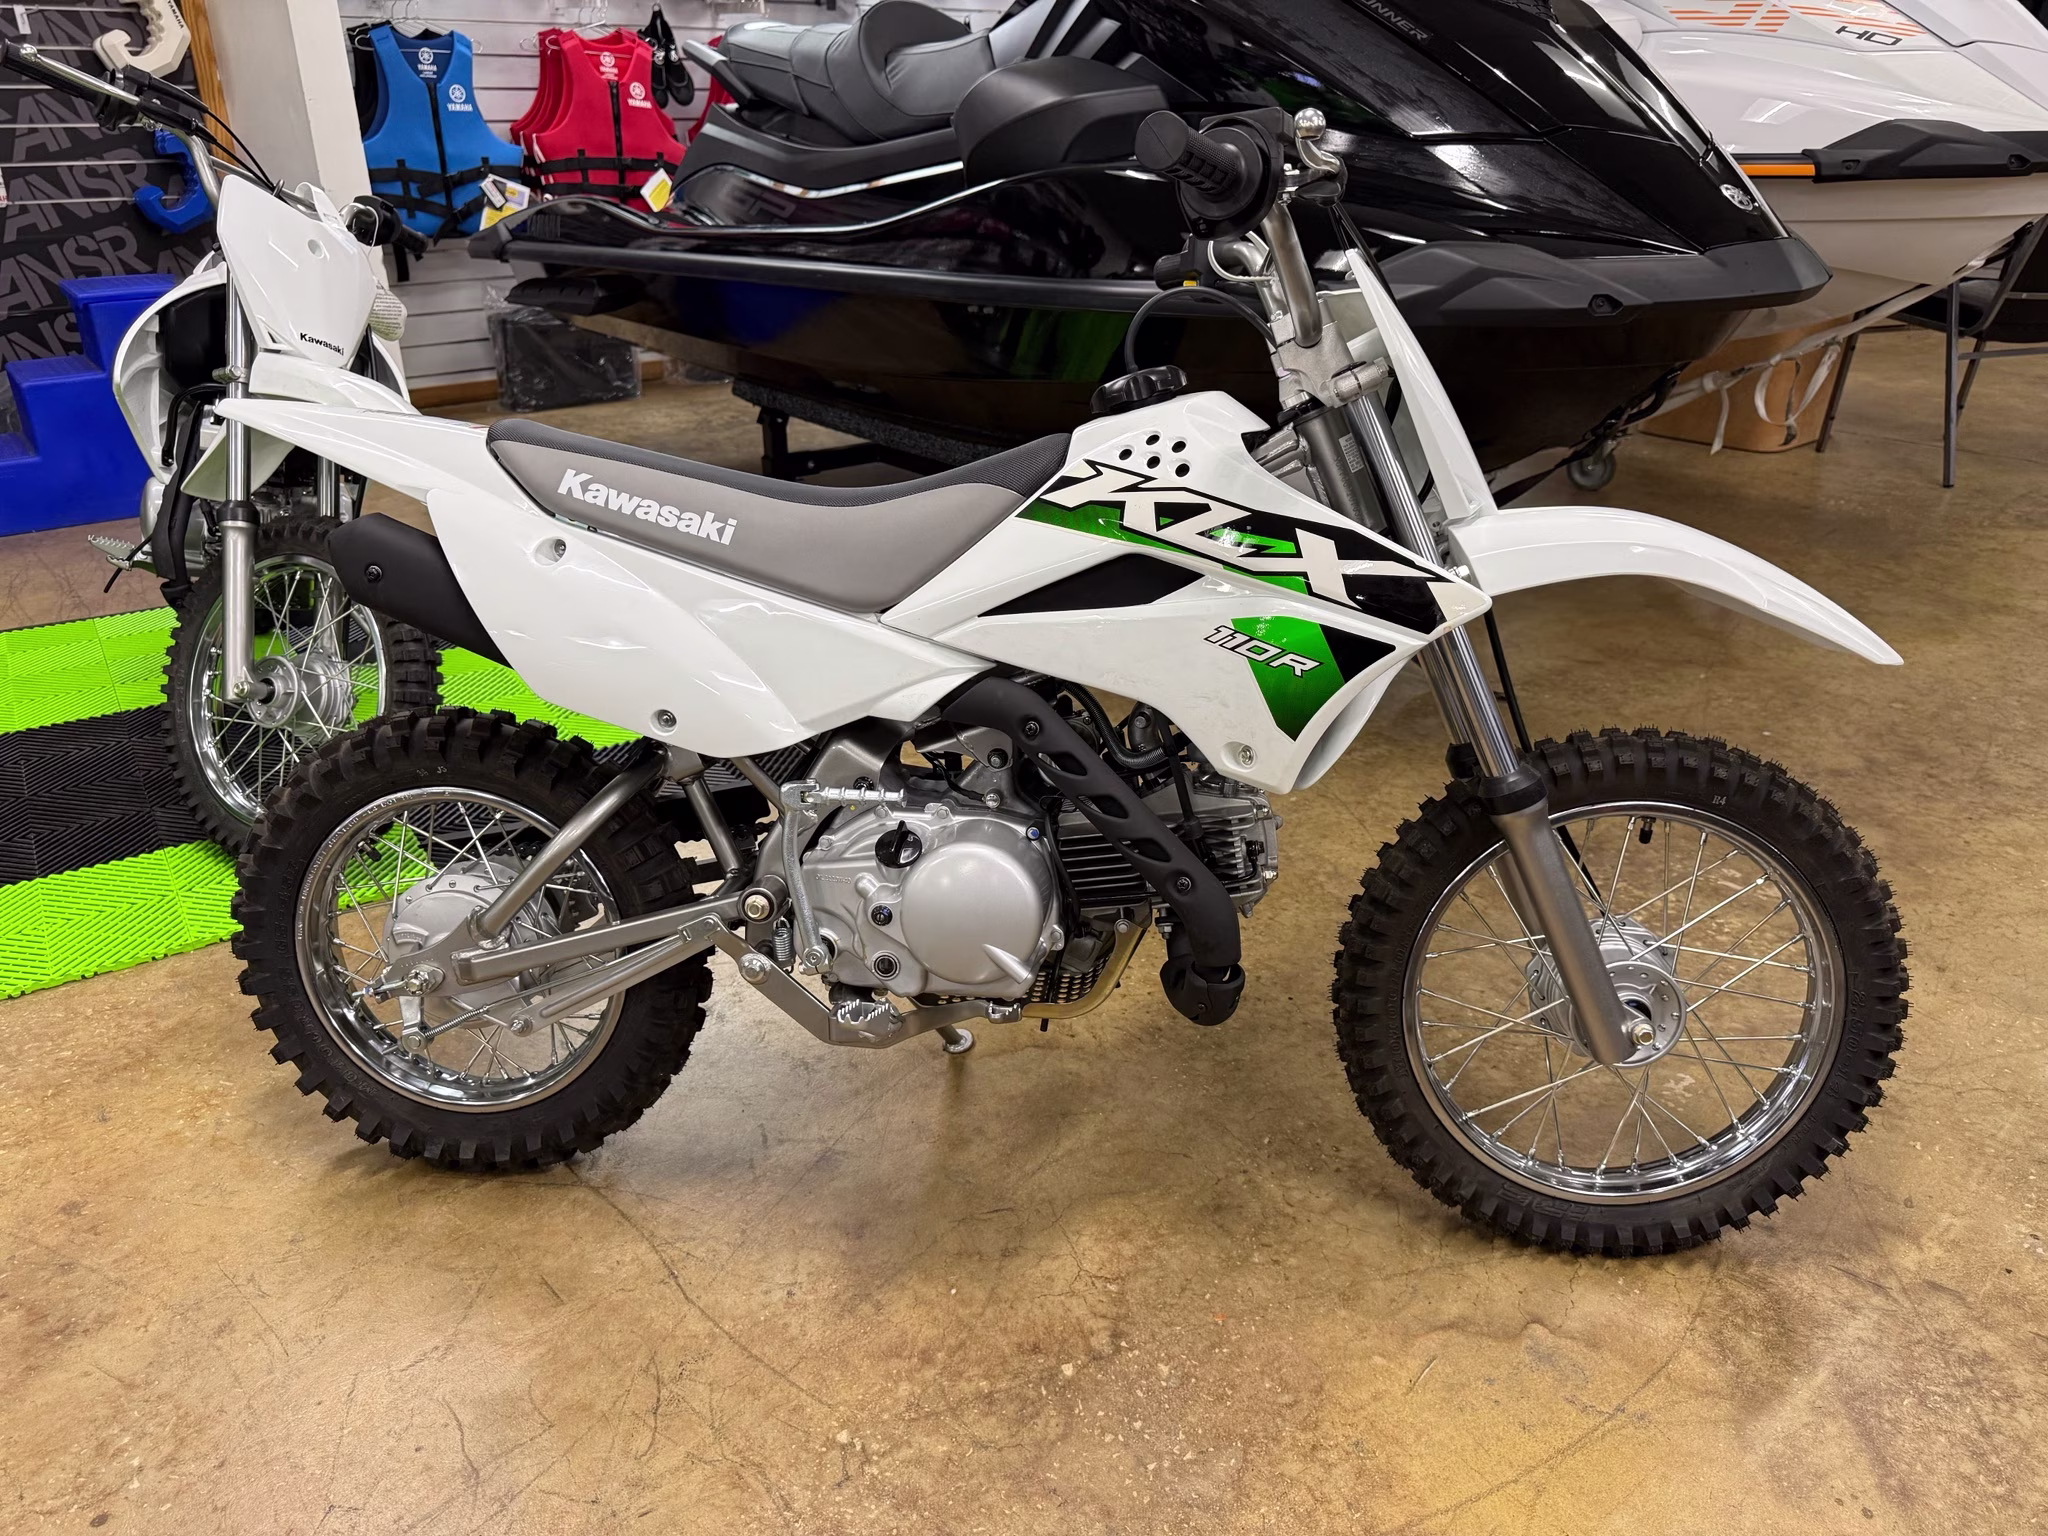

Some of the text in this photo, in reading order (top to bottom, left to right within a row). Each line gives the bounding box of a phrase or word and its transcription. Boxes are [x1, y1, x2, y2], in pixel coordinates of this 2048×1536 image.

[446, 102, 474, 112] YAMAHA
[4, 147, 150, 243] ANSR
[0, 224, 152, 320] ANSR
[300, 332, 345, 356] Kawasaki
[556, 468, 739, 546] Kawasaki
[1038, 460, 1440, 609] KLX
[1203, 624, 1324, 678] 110R
